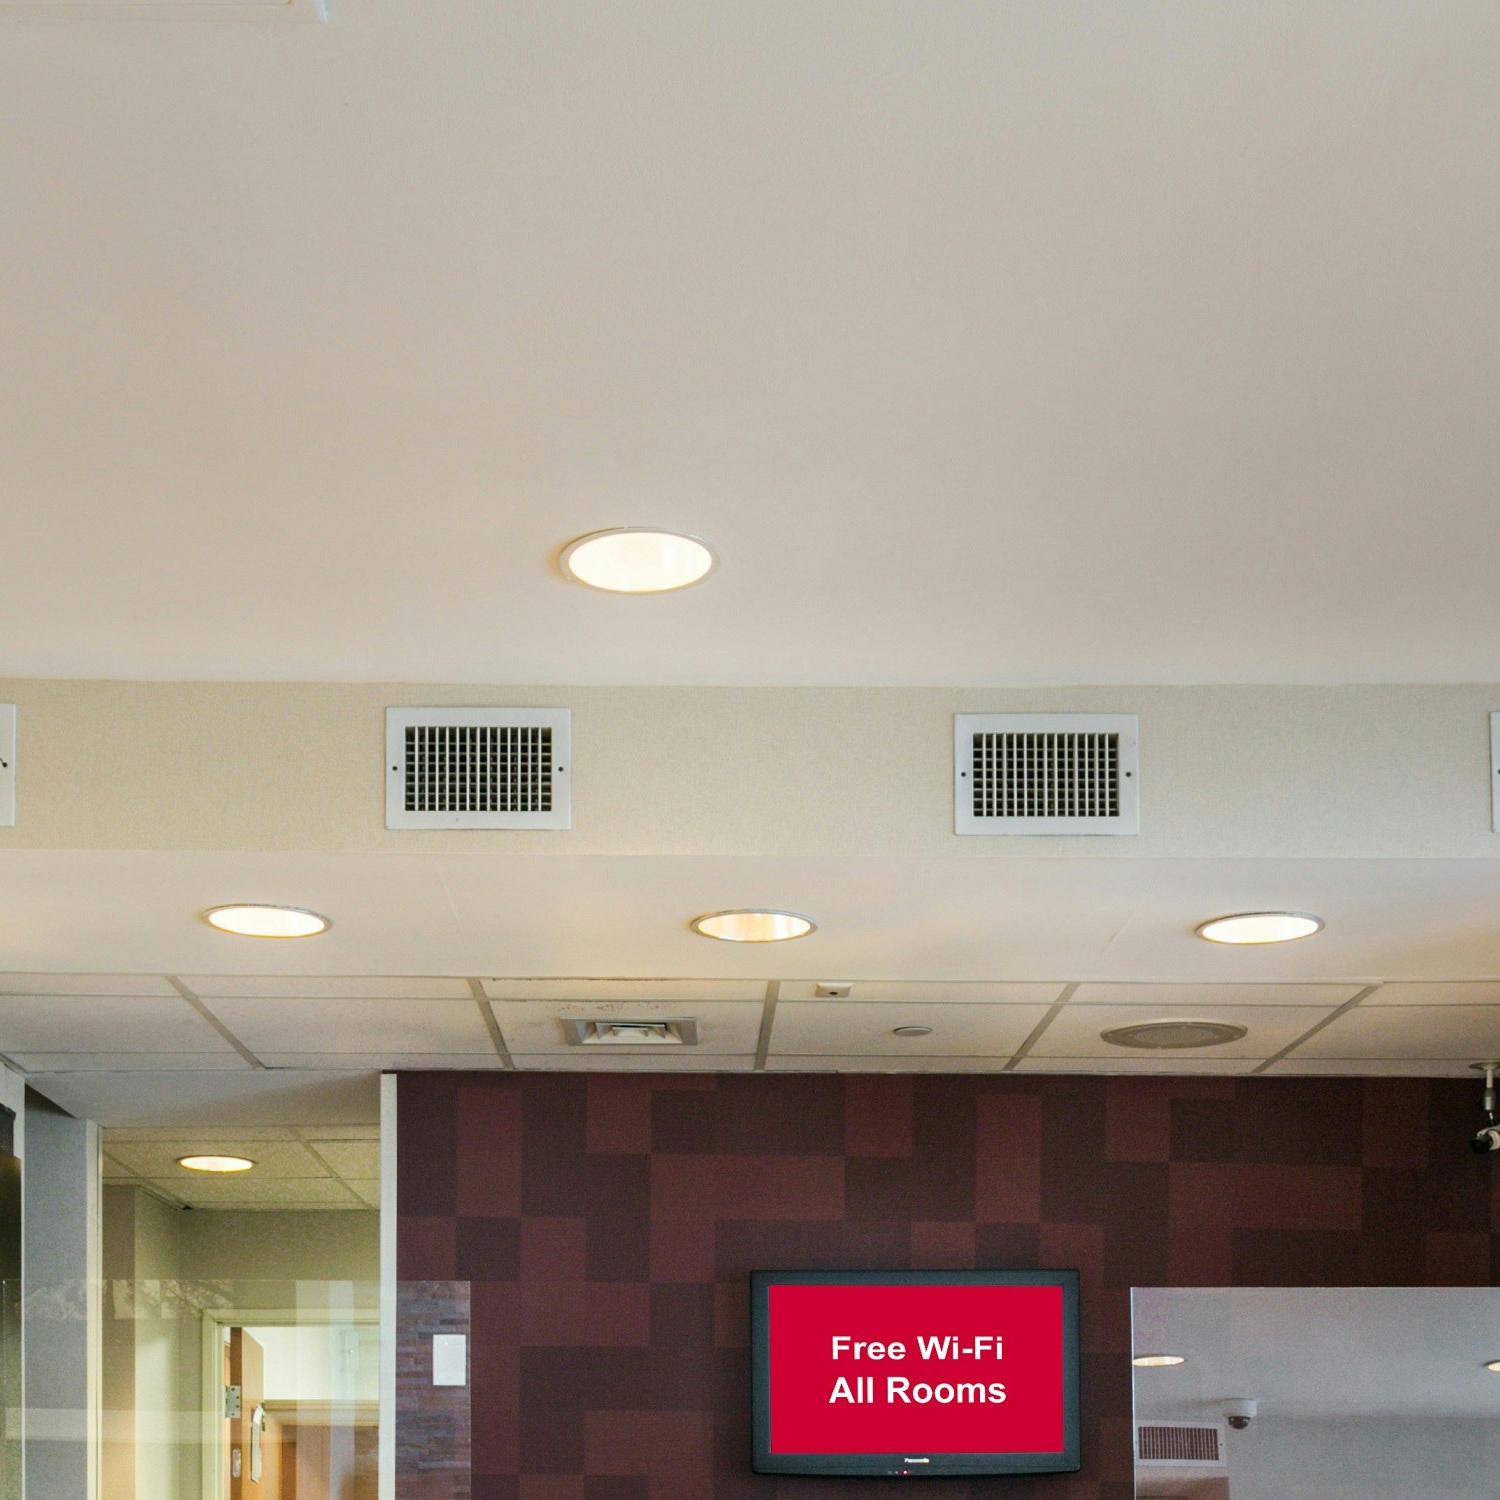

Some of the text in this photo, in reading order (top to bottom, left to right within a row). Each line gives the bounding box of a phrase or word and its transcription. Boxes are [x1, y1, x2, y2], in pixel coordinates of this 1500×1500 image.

[831, 1335, 1004, 1361] Free Wi-Fi
[828, 1376, 1007, 1405] All Rooms
